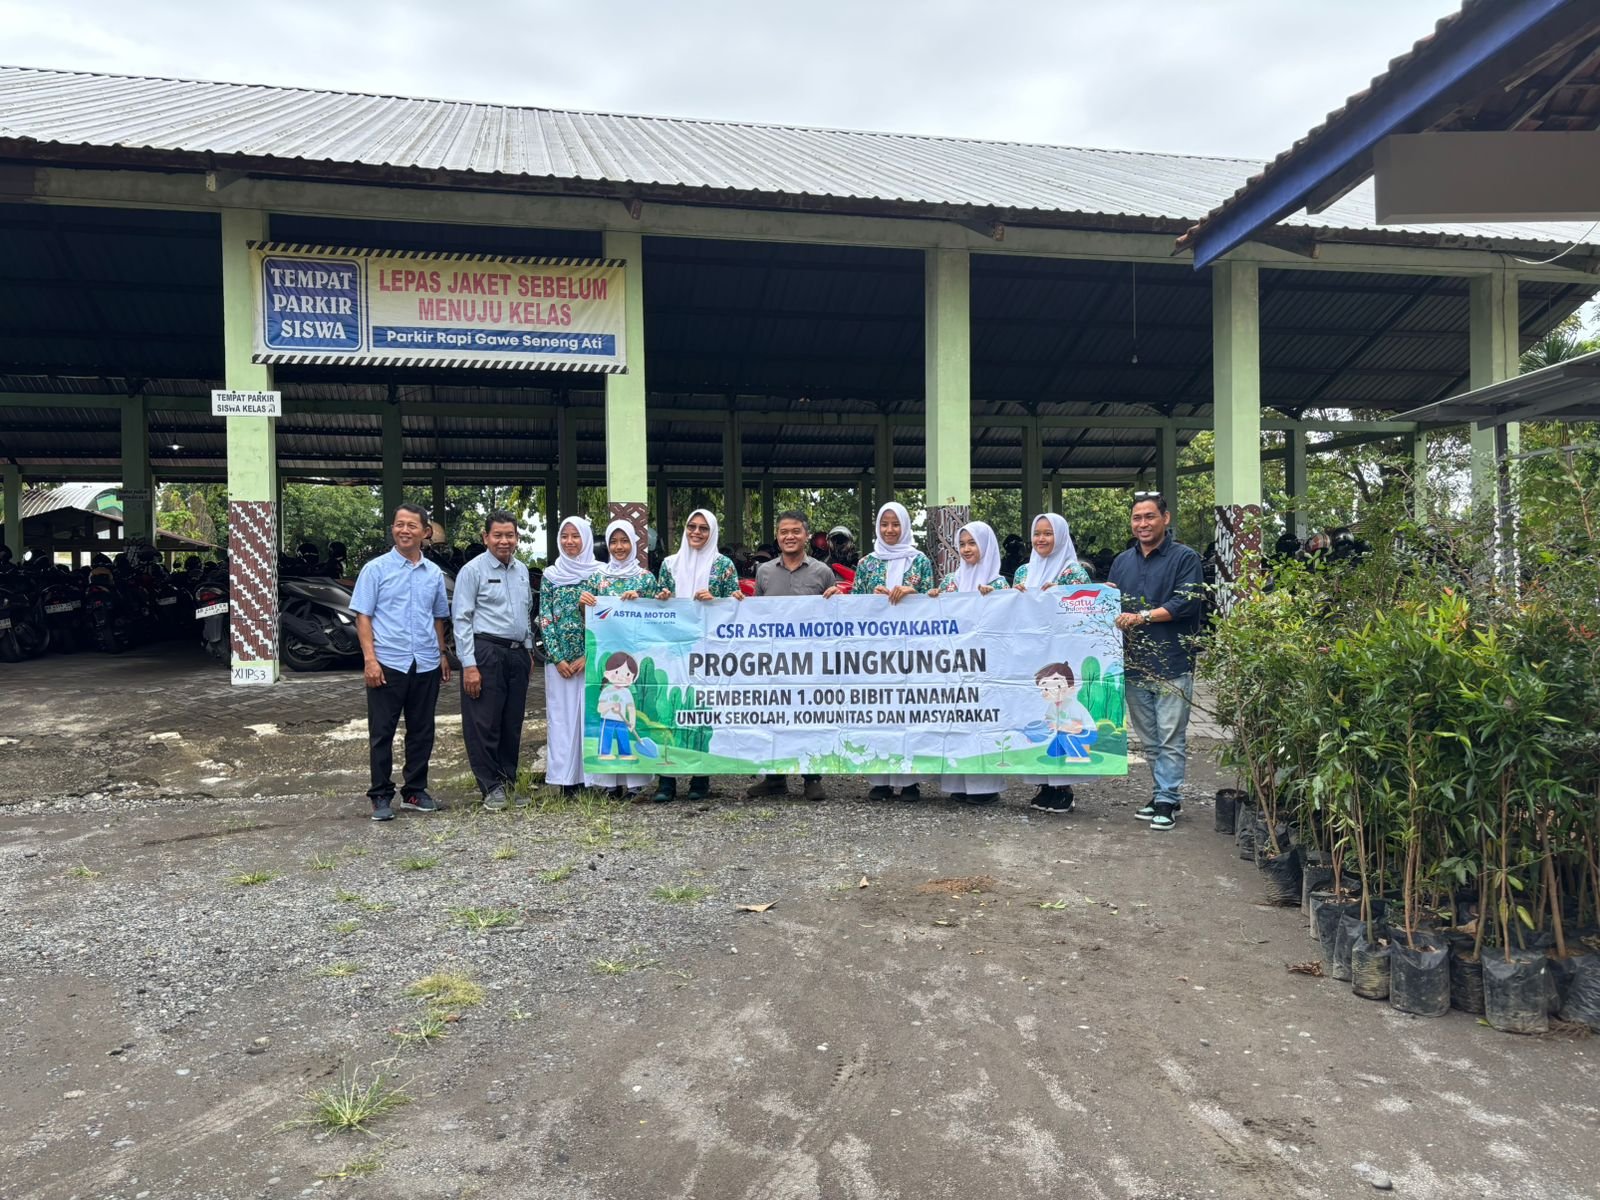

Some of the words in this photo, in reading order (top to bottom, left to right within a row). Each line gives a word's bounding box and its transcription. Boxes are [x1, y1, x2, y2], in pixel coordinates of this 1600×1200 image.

[271, 268, 352, 290] TEMPAT
[379, 269, 441, 293] LEPAS
[447, 271, 512, 296] JAKET
[518, 274, 607, 300] SEBELUM
[273, 294, 352, 315] PARKIR
[418, 298, 502, 323] MENUJU
[509, 301, 572, 326] KELAS
[281, 319, 346, 339] SISWA
[387, 330, 434, 343] Parkir
[437, 332, 472, 346] Rapi
[475, 333, 519, 345] Gawe
[522, 335, 578, 351] Seneng
[582, 337, 603, 349] Ati
[217, 393, 246, 402] TEMPAT
[248, 394, 275, 403] PARKIR
[217, 404, 241, 412] SISWA
[242, 404, 267, 413] KELAS
[613, 610, 642, 618] ASTRA
[644, 611, 677, 619] MOTOR
[716, 623, 745, 639] CSR
[748, 623, 796, 638] ASTRA
[799, 621, 855, 637] MOTOR
[857, 620, 960, 636] YOGYAKARTA
[688, 652, 813, 677] PROGRAM
[822, 648, 986, 675] LINGKUNGAN
[695, 689, 792, 706] PEMBERIAN
[797, 688, 846, 706] 1.000
[850, 688, 893, 705] BIBIT
[895, 687, 979, 705] TANAMAN
[677, 711, 722, 725] UNTUK
[725, 711, 790, 726] SEKOLAH,
[793, 710, 873, 724] KOMUNITAS
[877, 710, 905, 724] DAN
[909, 708, 1000, 723] MASYARAKAT
